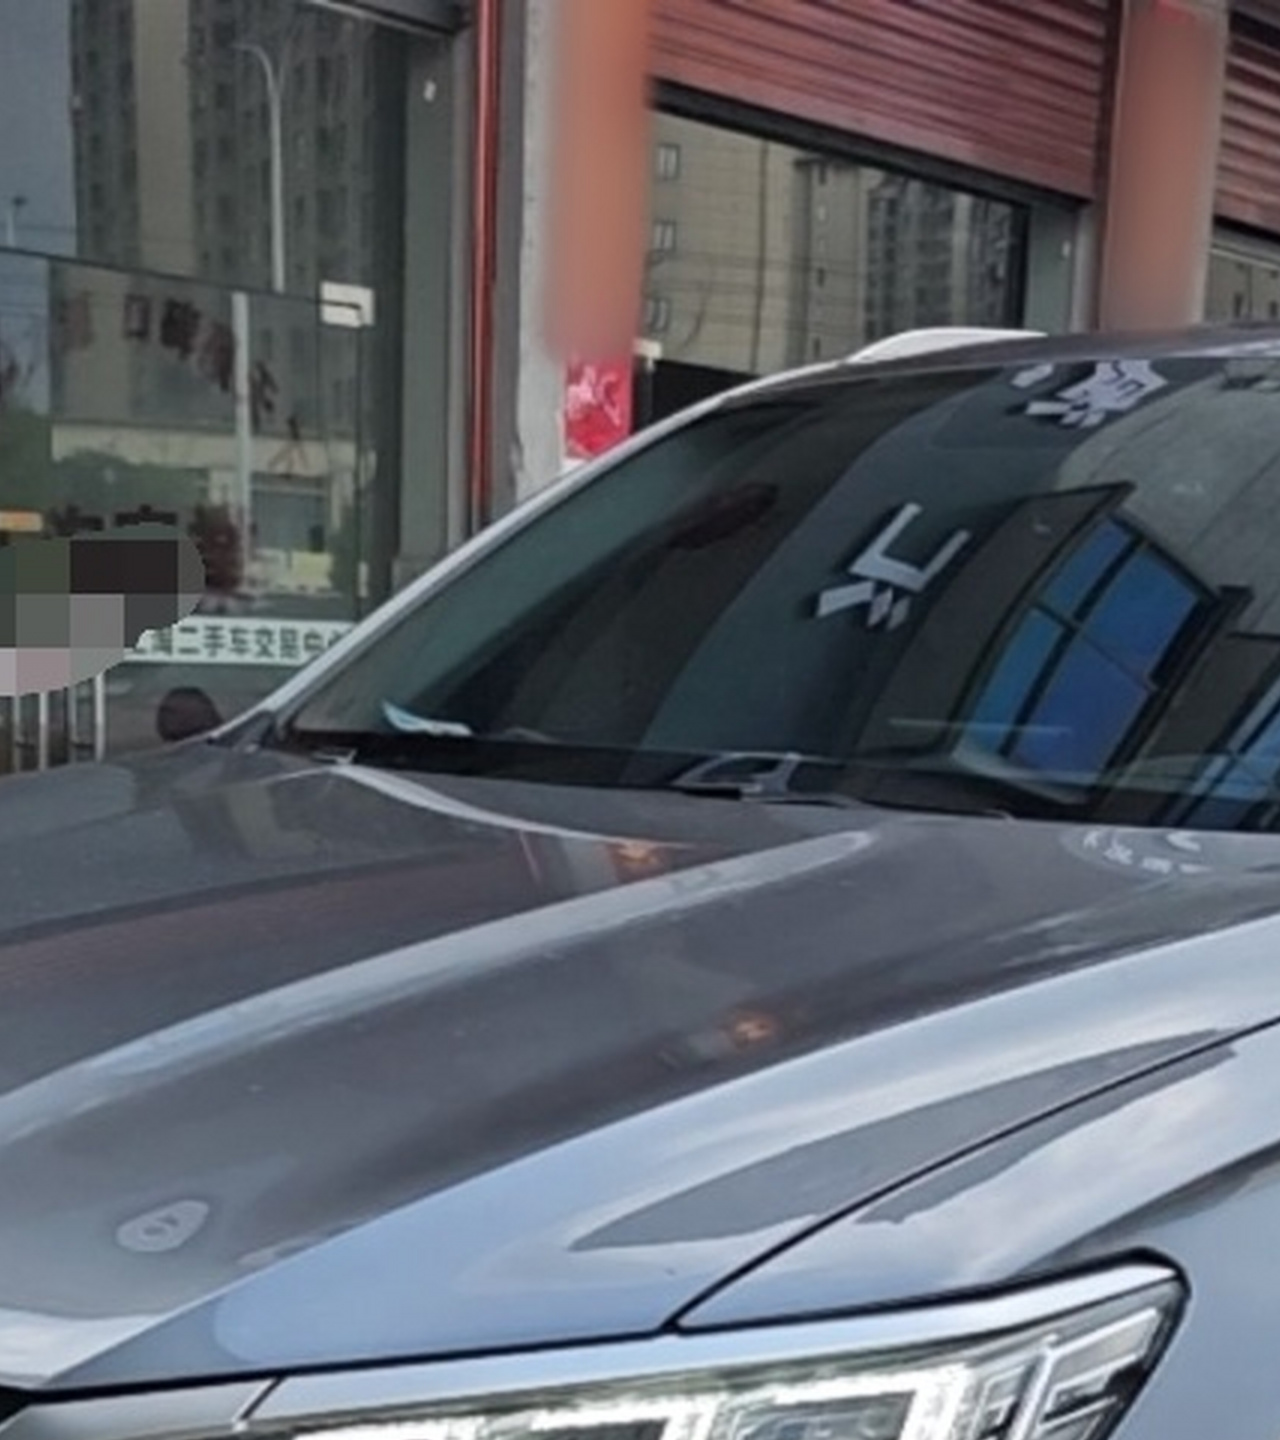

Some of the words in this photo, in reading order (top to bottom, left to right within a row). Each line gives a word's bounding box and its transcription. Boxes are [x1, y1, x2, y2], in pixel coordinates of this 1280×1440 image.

[134, 625, 345, 660] 二手车交易中
